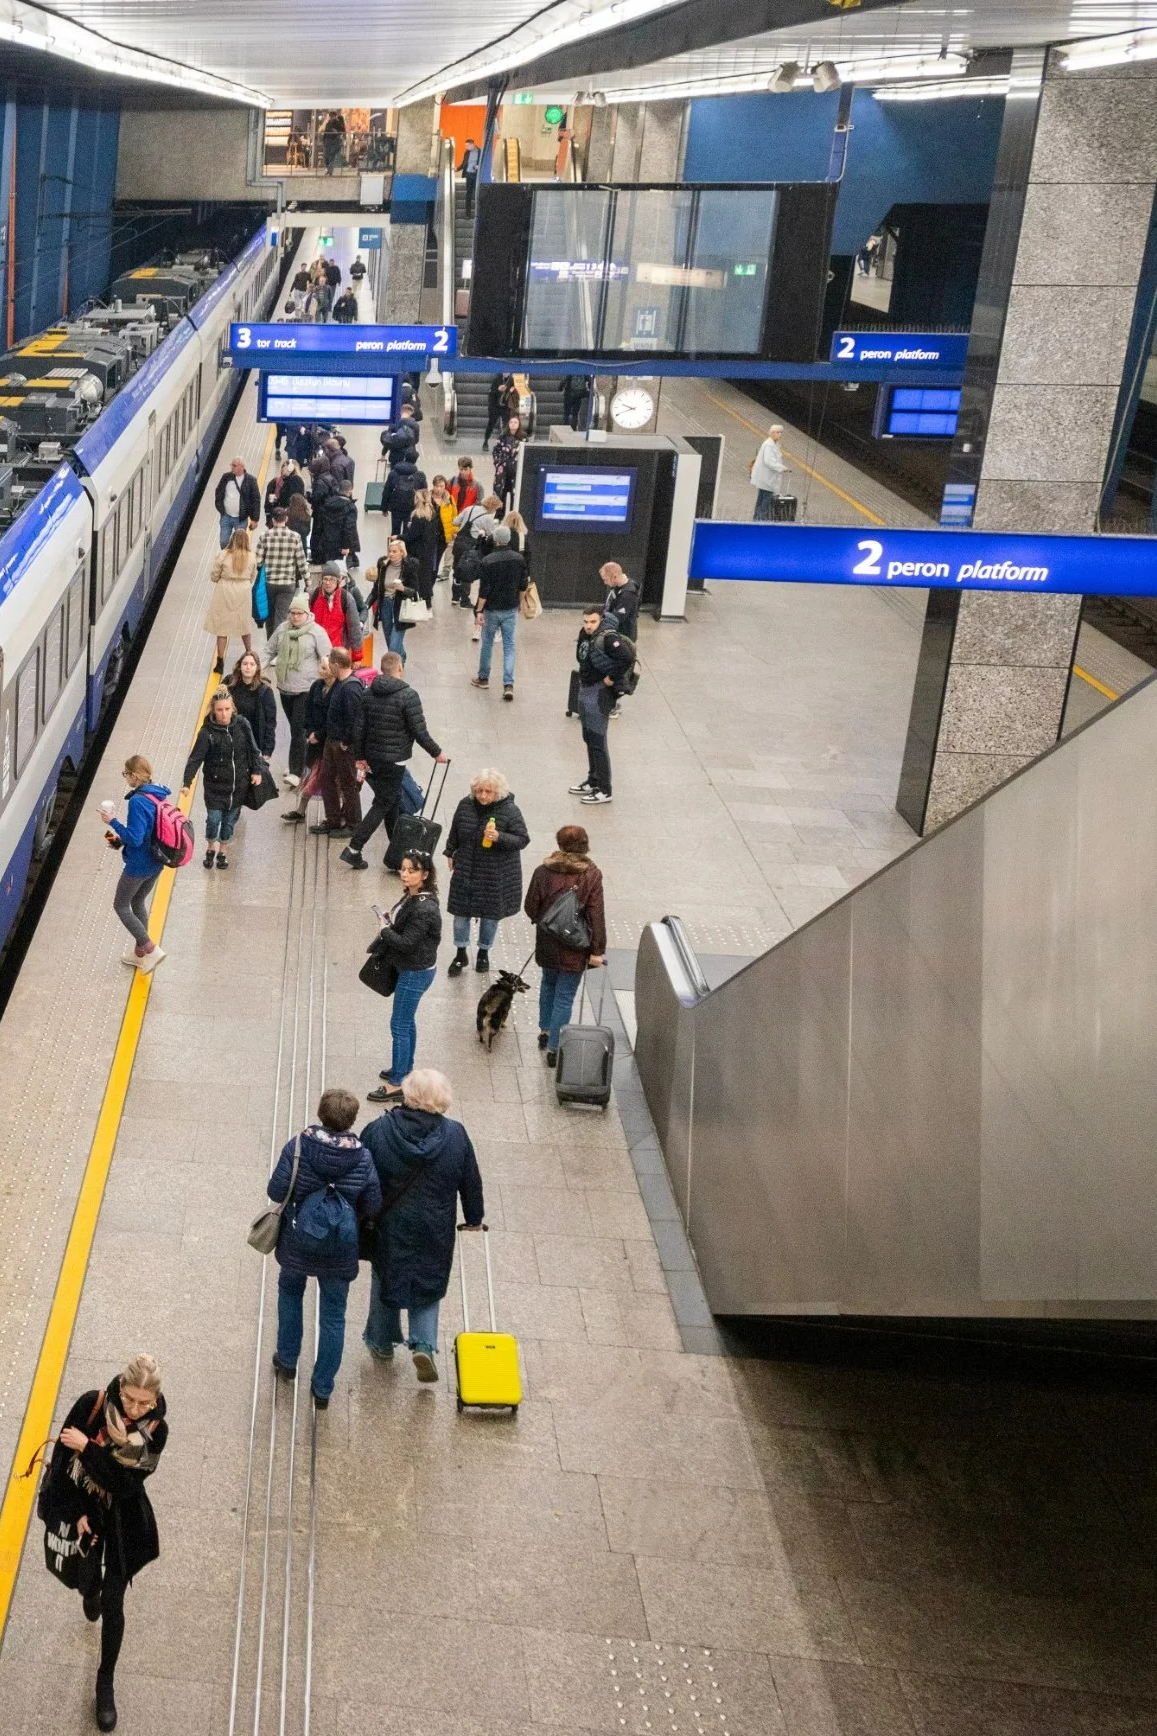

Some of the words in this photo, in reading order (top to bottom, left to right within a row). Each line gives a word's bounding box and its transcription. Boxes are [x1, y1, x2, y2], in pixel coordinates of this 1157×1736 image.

[237, 327, 252, 349] 3
[256, 338, 271, 349] tor
[274, 338, 297, 349] track
[355, 341, 384, 352] peron
[386, 340, 427, 352] platform
[432, 330, 450, 352] 2
[837, 337, 856, 359] 2
[859, 349, 892, 361] peron
[893, 348, 940, 362] platform
[852, 540, 884, 575] 2
[886, 560, 951, 580] peron
[955, 559, 1050, 583] platform
